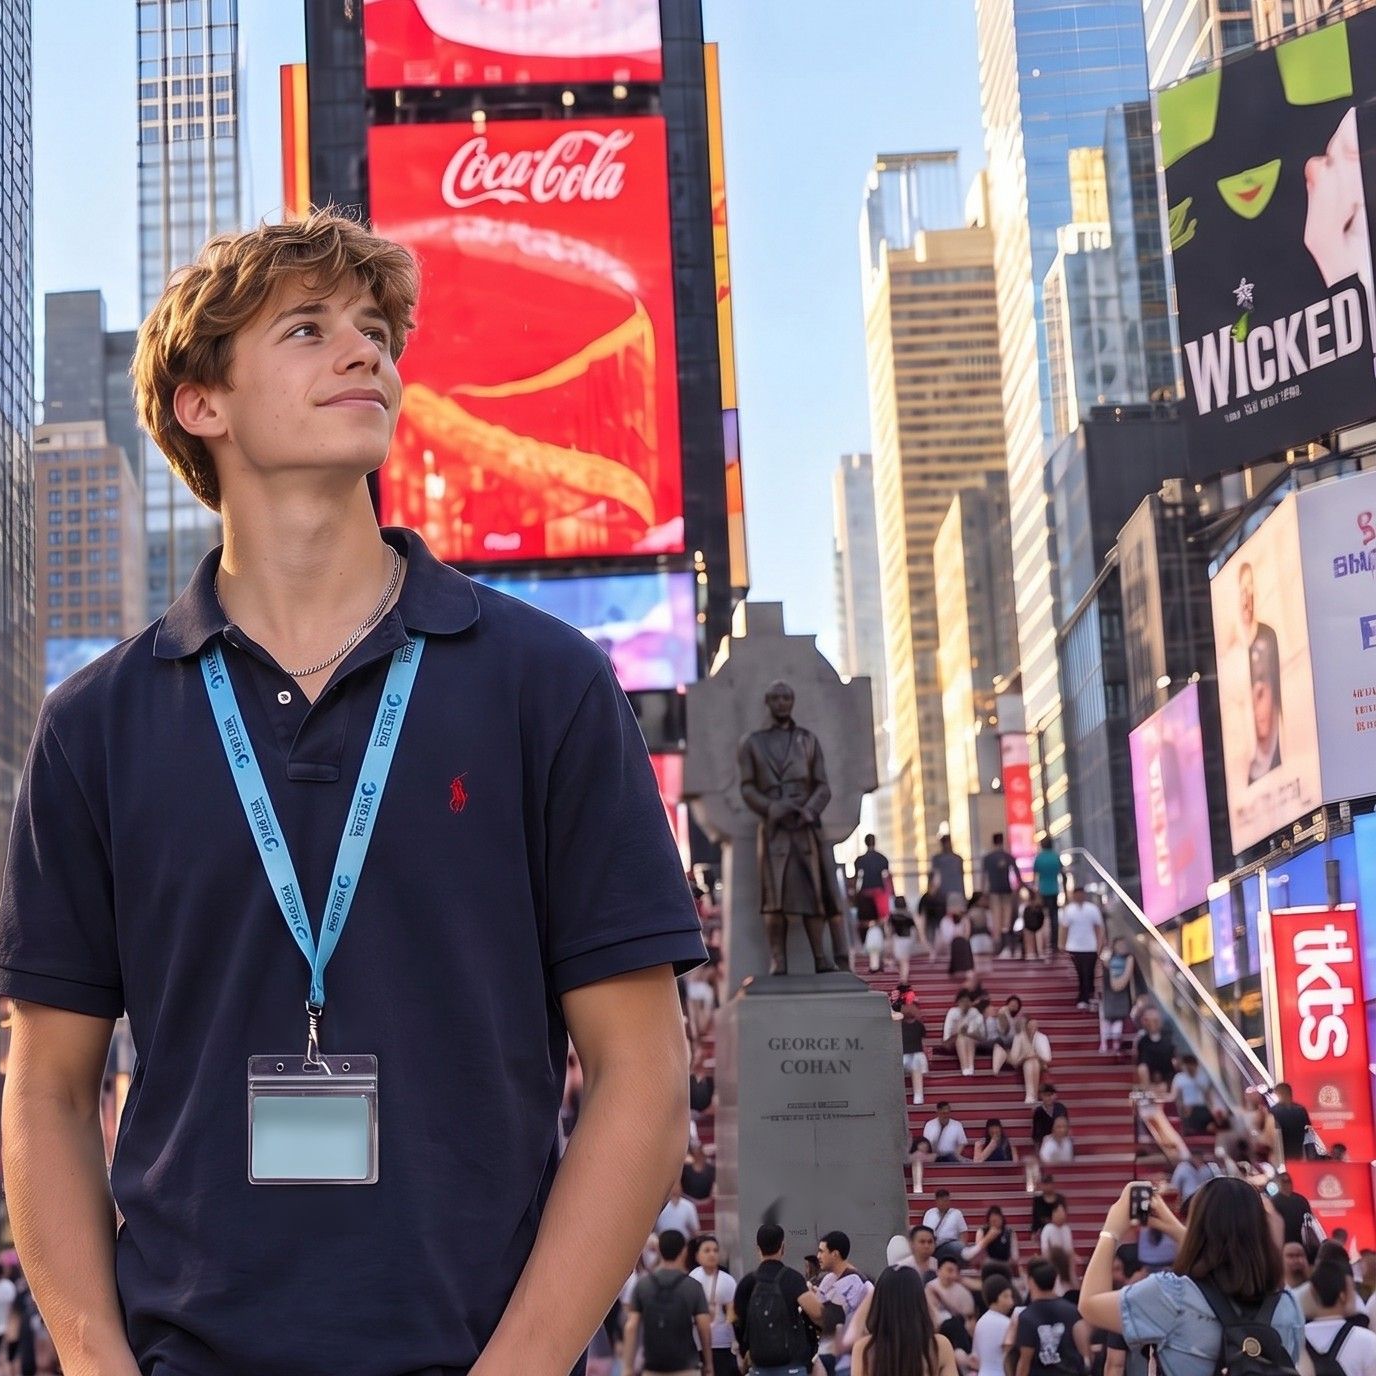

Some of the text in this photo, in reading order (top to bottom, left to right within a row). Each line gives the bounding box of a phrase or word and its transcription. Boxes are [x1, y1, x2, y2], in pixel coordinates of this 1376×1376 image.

[441, 128, 635, 209] Coca-Cola
[1184, 287, 1364, 416] WICKED
[1292, 923, 1355, 1062] tkts
[768, 1037, 864, 1051] GEORGE M.
[780, 1059, 852, 1075] COHAN
